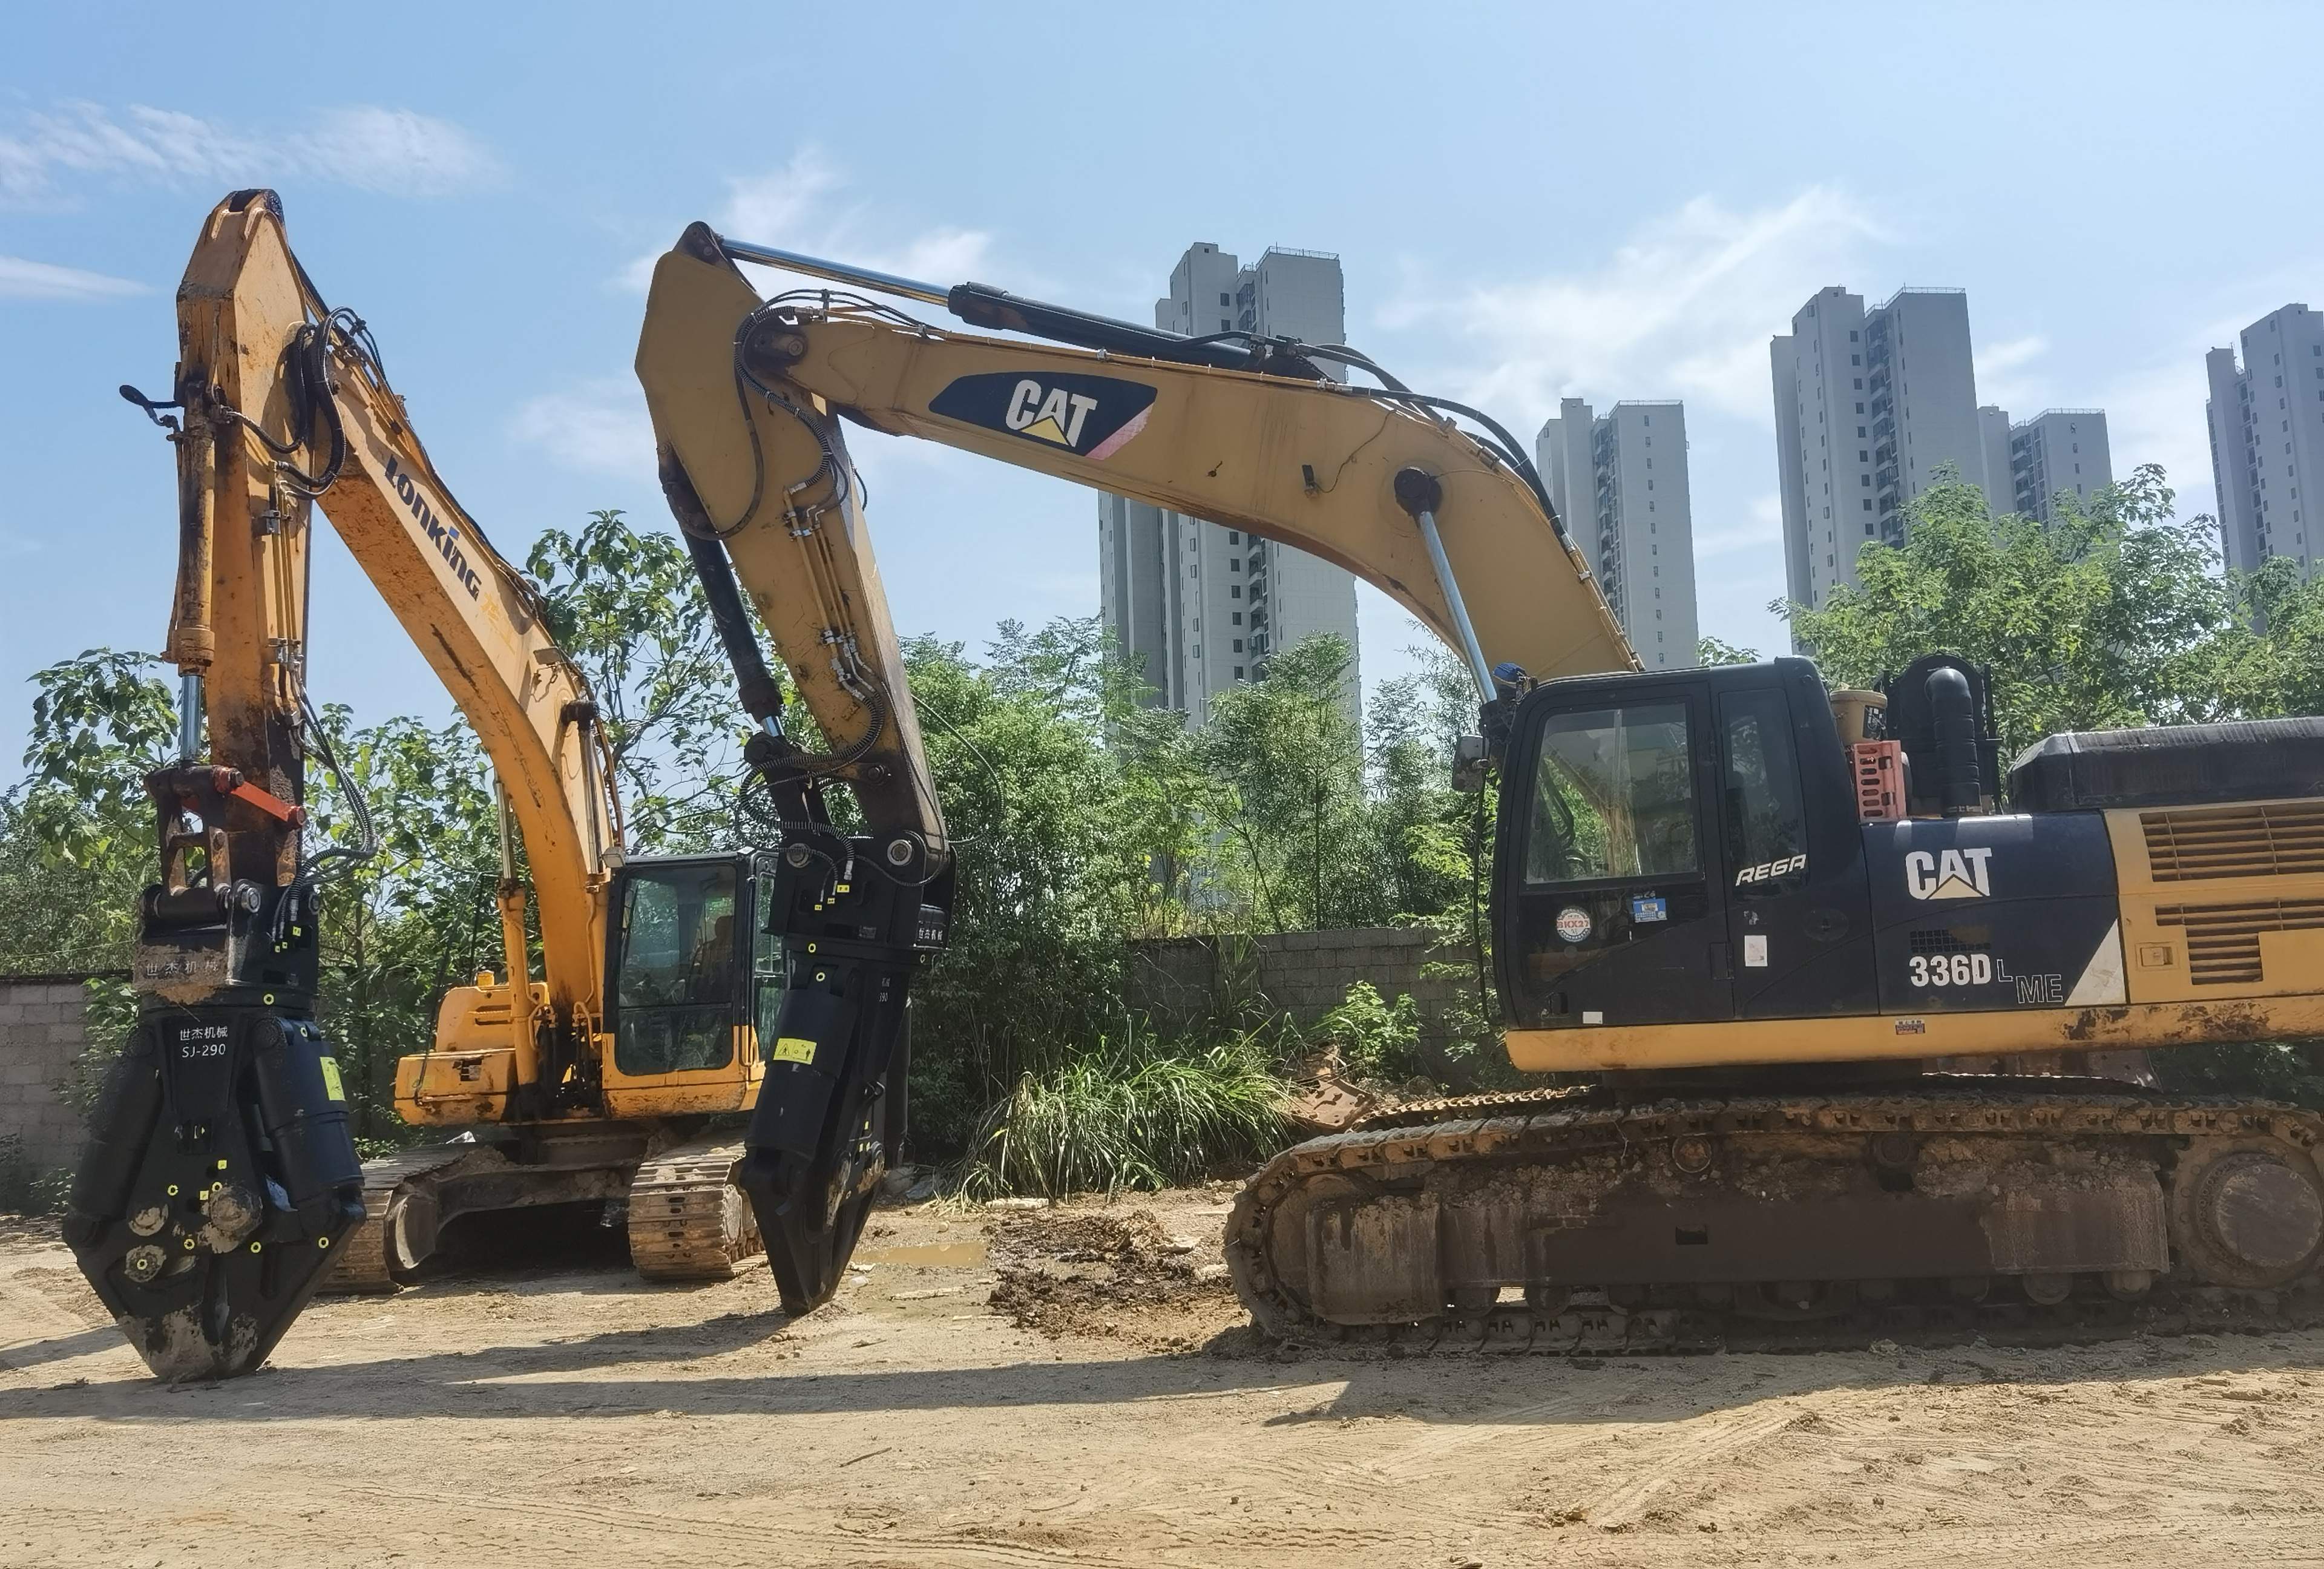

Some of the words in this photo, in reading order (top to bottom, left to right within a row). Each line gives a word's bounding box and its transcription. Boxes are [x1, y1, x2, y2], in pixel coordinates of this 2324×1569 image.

[1006, 379, 1098, 447] CAT
[1736, 854, 1807, 886] REGA
[1906, 847, 1992, 900] CAT
[1909, 953, 1992, 987] 336D
[1997, 959, 2014, 982] L
[2016, 974, 2064, 1004] ME
[180, 1025, 228, 1041] 世杰机械
[182, 1044, 226, 1058] SJ-290
